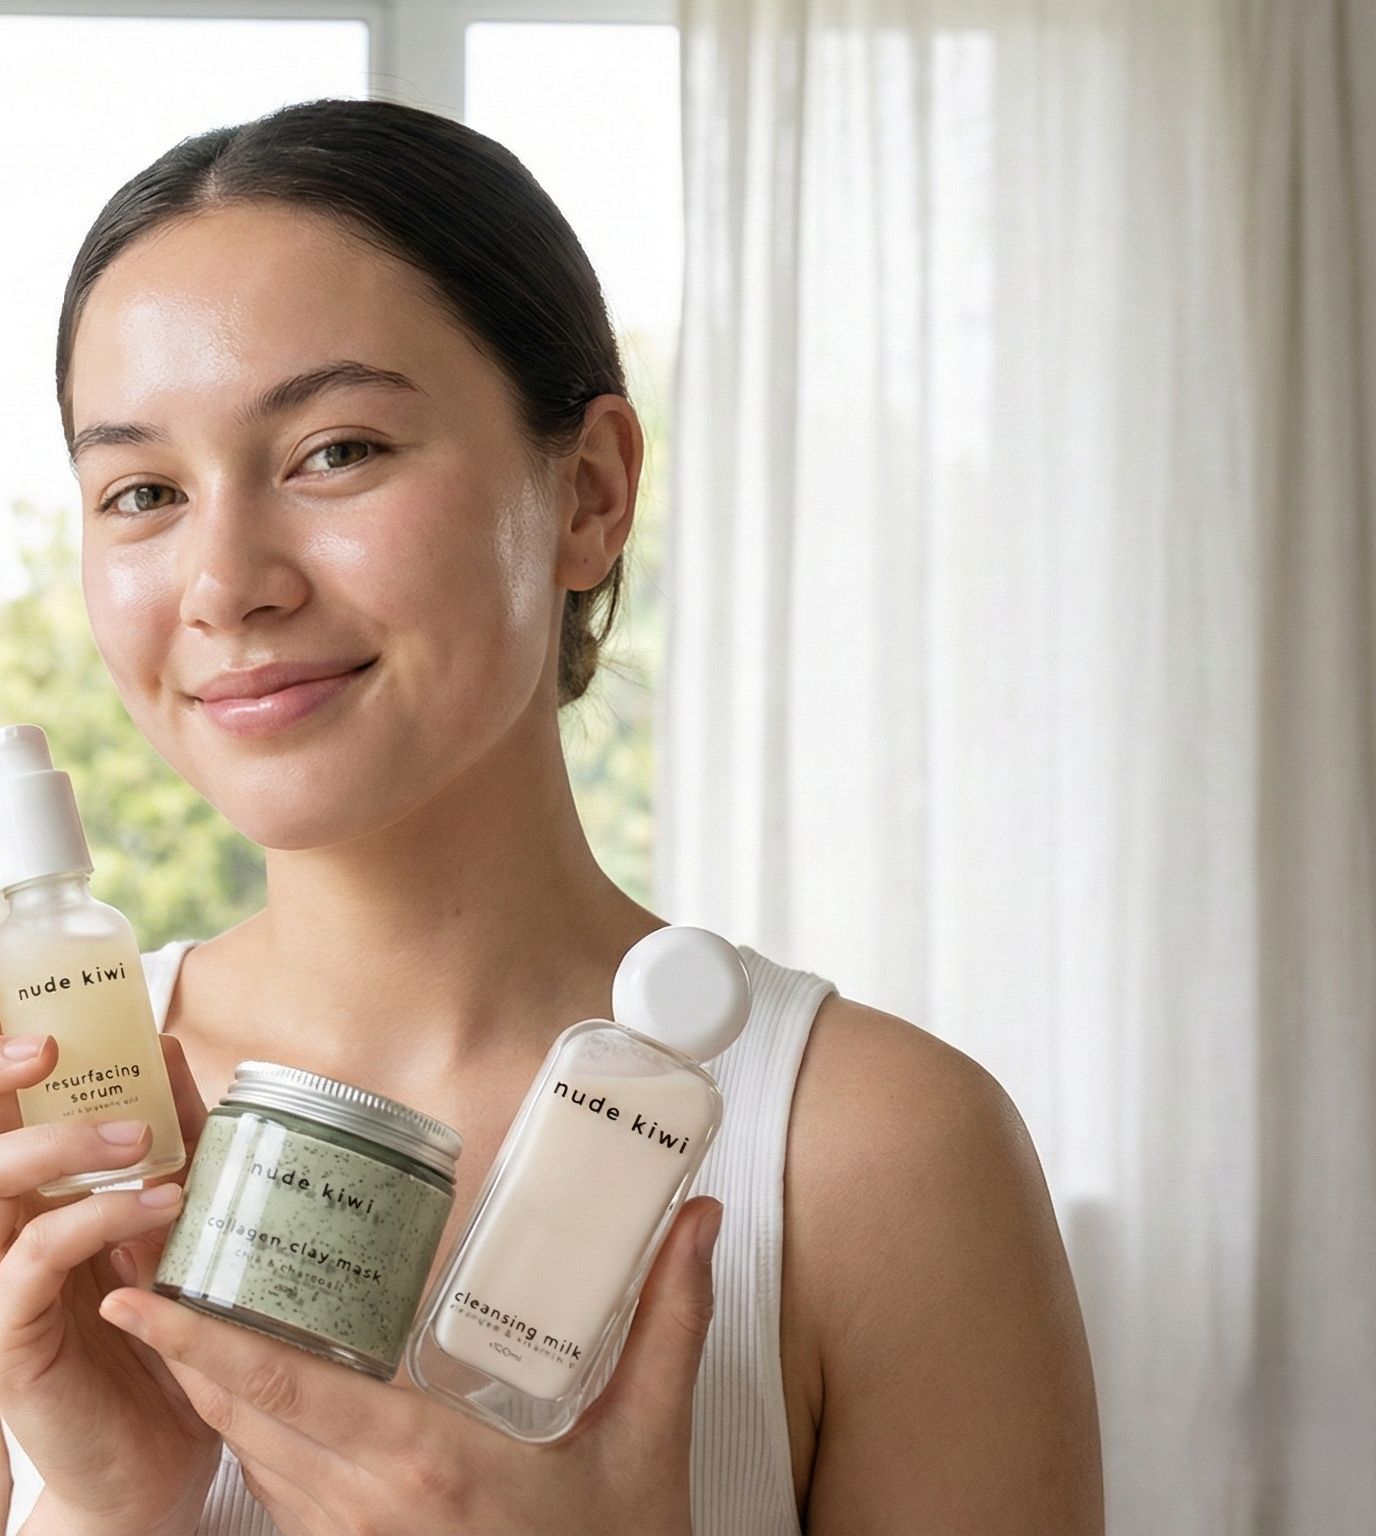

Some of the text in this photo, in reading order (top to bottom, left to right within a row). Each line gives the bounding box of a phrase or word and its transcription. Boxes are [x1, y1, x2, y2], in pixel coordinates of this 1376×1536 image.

[18, 962, 125, 1000] nude kiwi
[45, 1065, 140, 1092] resurfacing
[71, 1085, 123, 1103] serum
[554, 1081, 689, 1154] nude kiwi
[251, 1163, 373, 1214] nude kiwi
[208, 1216, 381, 1285] collagen clay mask
[454, 1292, 537, 1340] cleansing
[543, 1335, 581, 1360] milk
